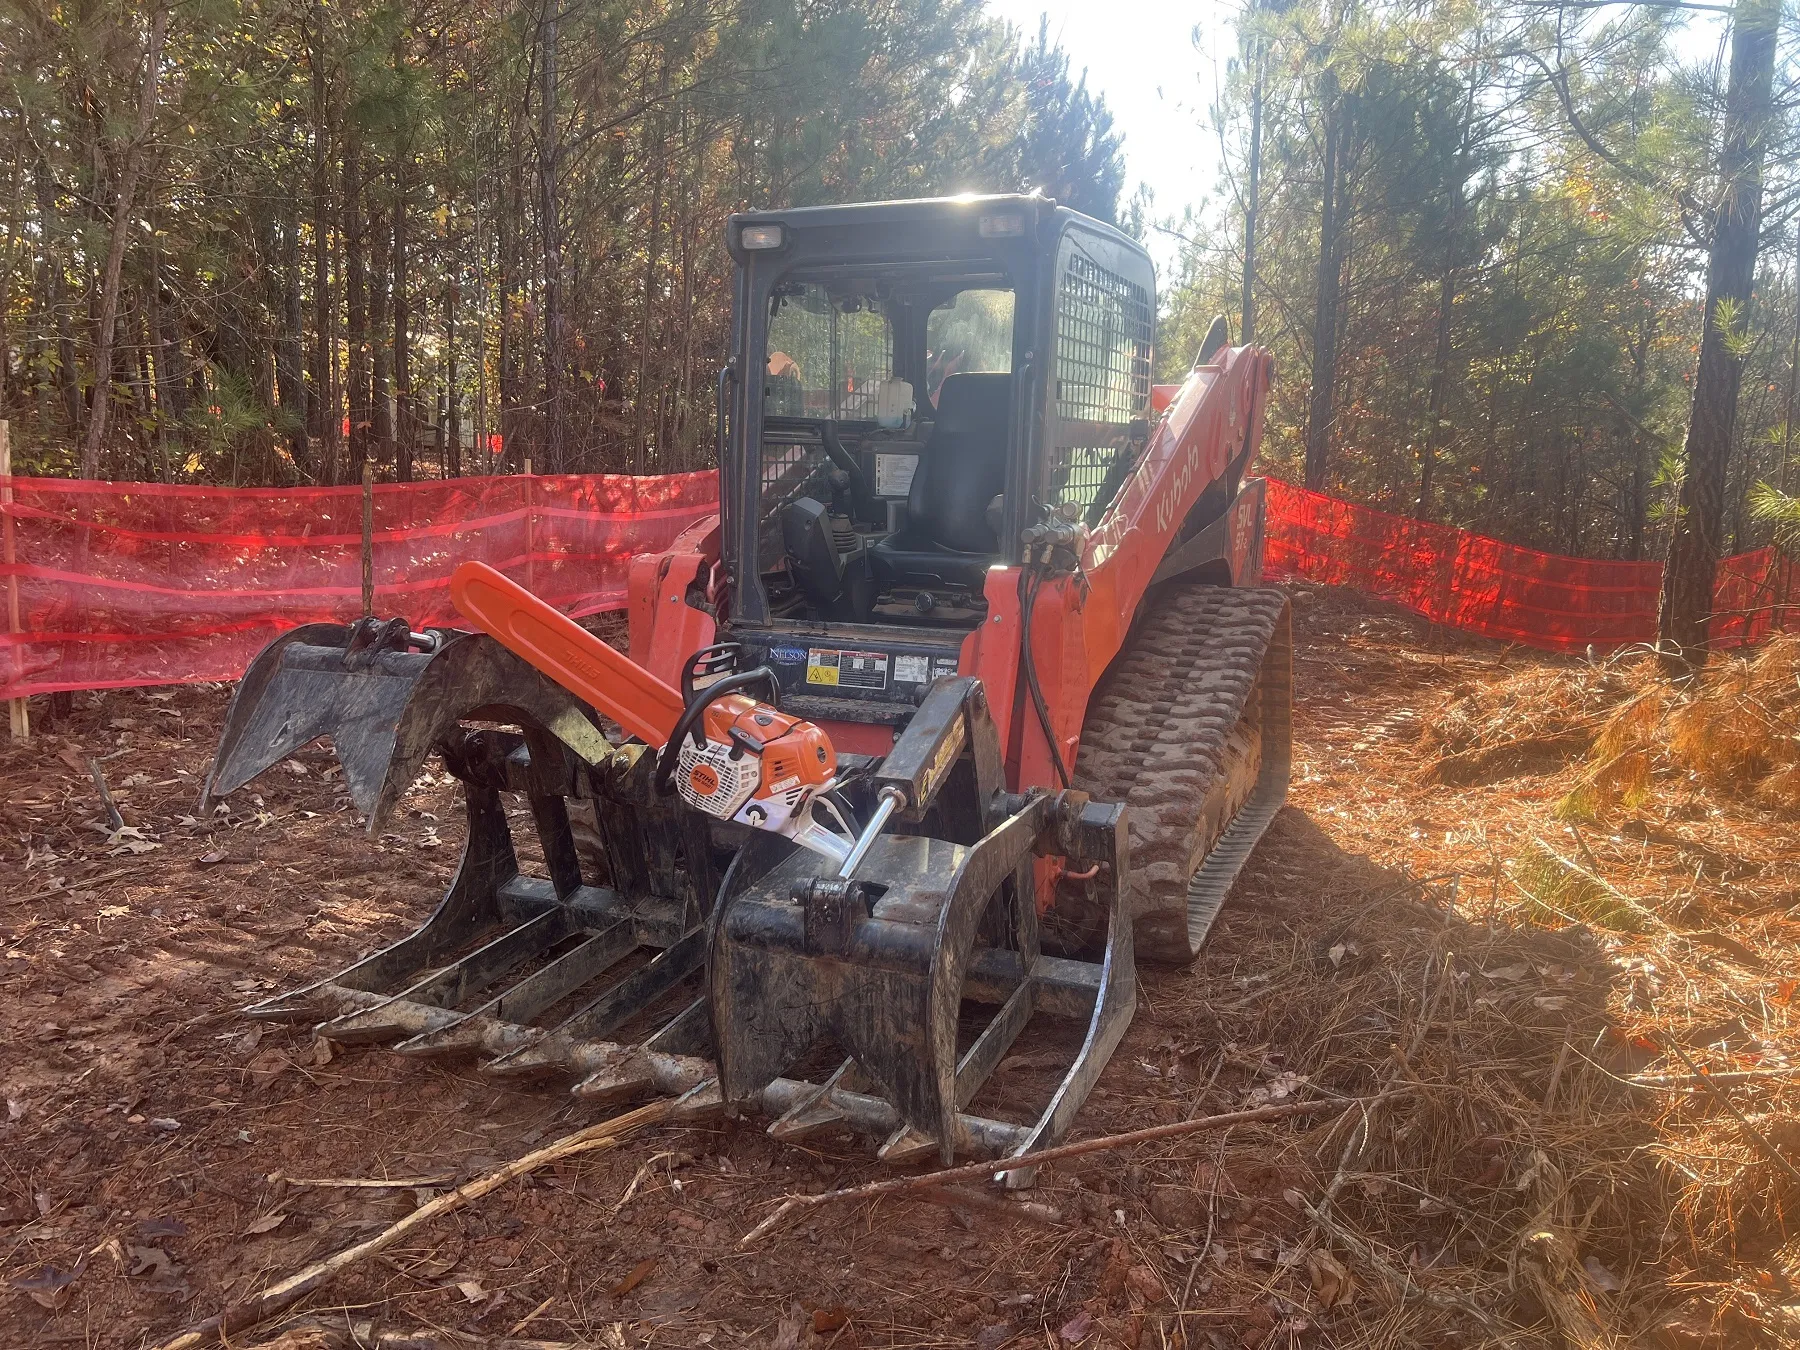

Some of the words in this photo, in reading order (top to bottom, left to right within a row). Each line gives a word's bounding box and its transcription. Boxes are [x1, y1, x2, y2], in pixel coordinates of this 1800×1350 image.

[1156, 444, 1199, 533] Kubota
[1236, 503, 1252, 530] SVL
[769, 648, 807, 661] NELSON
[692, 769, 716, 787] STIHL
